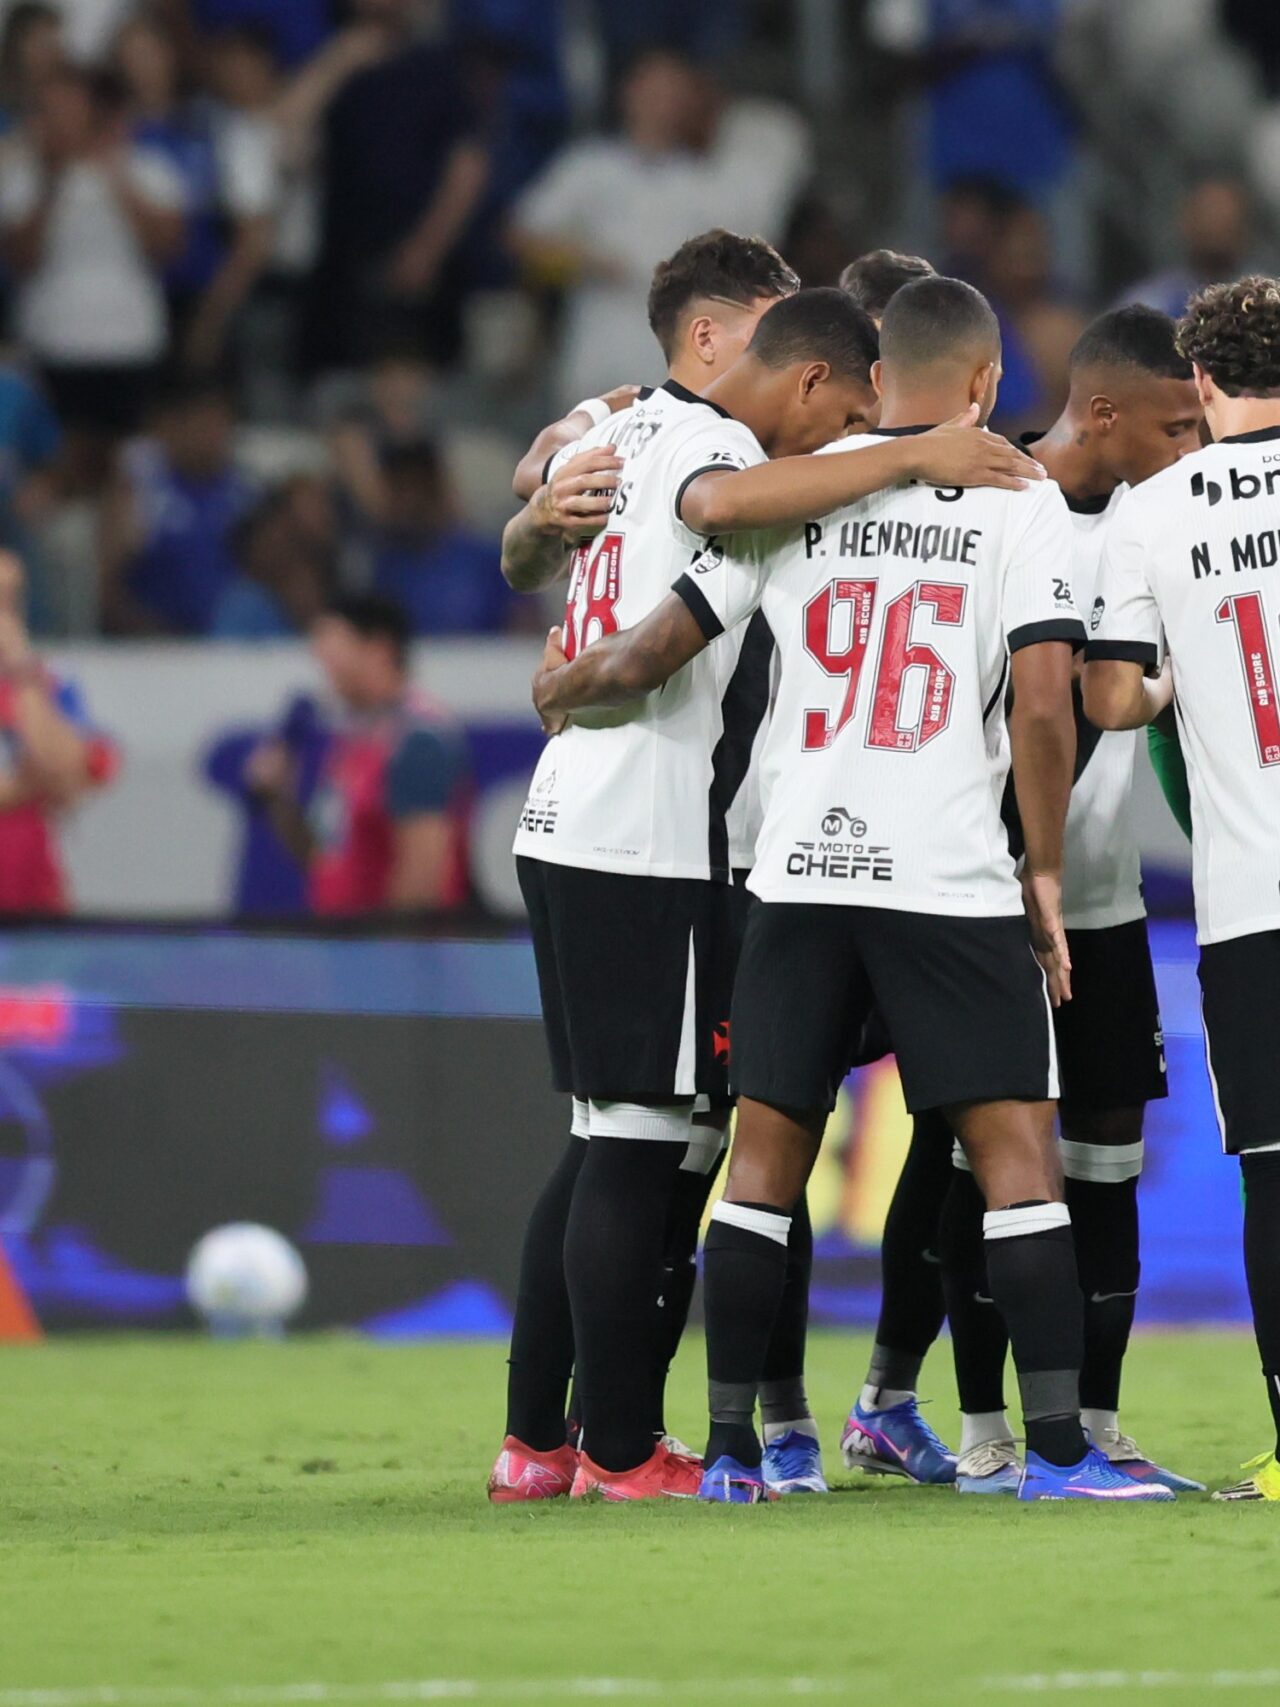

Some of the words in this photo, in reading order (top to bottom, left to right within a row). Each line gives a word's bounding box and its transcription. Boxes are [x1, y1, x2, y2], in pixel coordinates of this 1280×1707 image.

[804, 522, 826, 559] P.
[839, 520, 982, 566] HENRIQUE
[1190, 542, 1221, 579] N.
[860, 591, 872, 625] SCORE
[802, 577, 968, 753] 96
[1251, 652, 1266, 687] SCORE
[932, 668, 947, 703] SCORE
[518, 807, 558, 834] HEFE
[818, 842, 865, 854] MOTO
[786, 853, 894, 881] CHEFE
